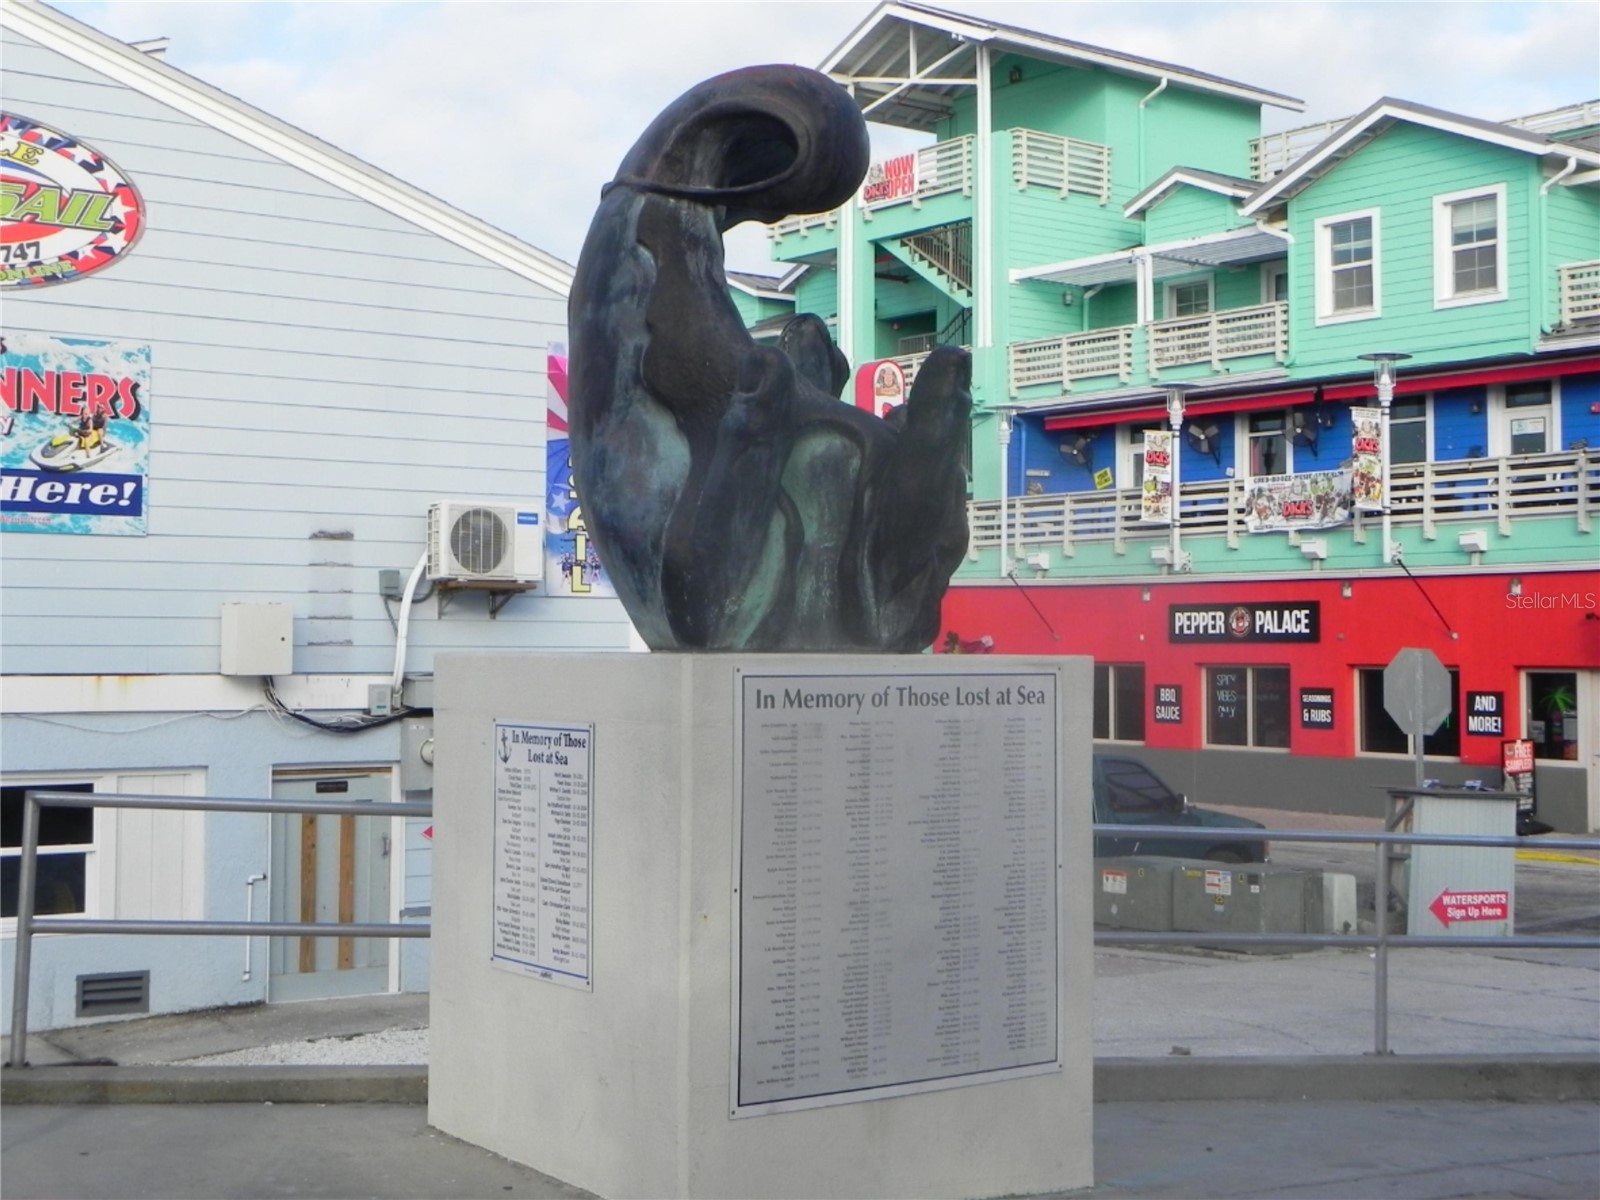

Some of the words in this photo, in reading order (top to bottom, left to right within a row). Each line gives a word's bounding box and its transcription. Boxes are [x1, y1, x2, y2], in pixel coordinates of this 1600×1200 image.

[885, 154, 914, 179] NOW
[887, 175, 914, 199] OPEN
[1175, 610, 1225, 634] PEPPER
[1255, 609, 1310, 634] PALACE
[756, 688, 776, 709] In
[782, 688, 865, 715] Memory
[871, 686, 891, 707] of
[896, 686, 949, 707] Those
[956, 686, 990, 706] Lost
[996, 688, 1011, 705] at
[1017, 685, 1046, 705] Sea
[1159, 688, 1176, 703] BBQ
[1474, 695, 1497, 712] AND
[1156, 706, 1180, 720] SAUCE
[1310, 709, 1332, 723] RUBS
[1468, 715, 1502, 732] MORE!
[512, 730, 520, 743] In
[521, 731, 552, 749] Memory
[554, 733, 562, 747] of
[563, 733, 587, 748] Those
[528, 749, 545, 763] Lost
[545, 752, 554, 764] at
[555, 751, 568, 765] Sea
[1442, 894, 1507, 905] WATERSPORTS
[1447, 907, 1466, 919] Sign
[1467, 906, 1480, 918] Up
[1481, 906, 1502, 916] Here
